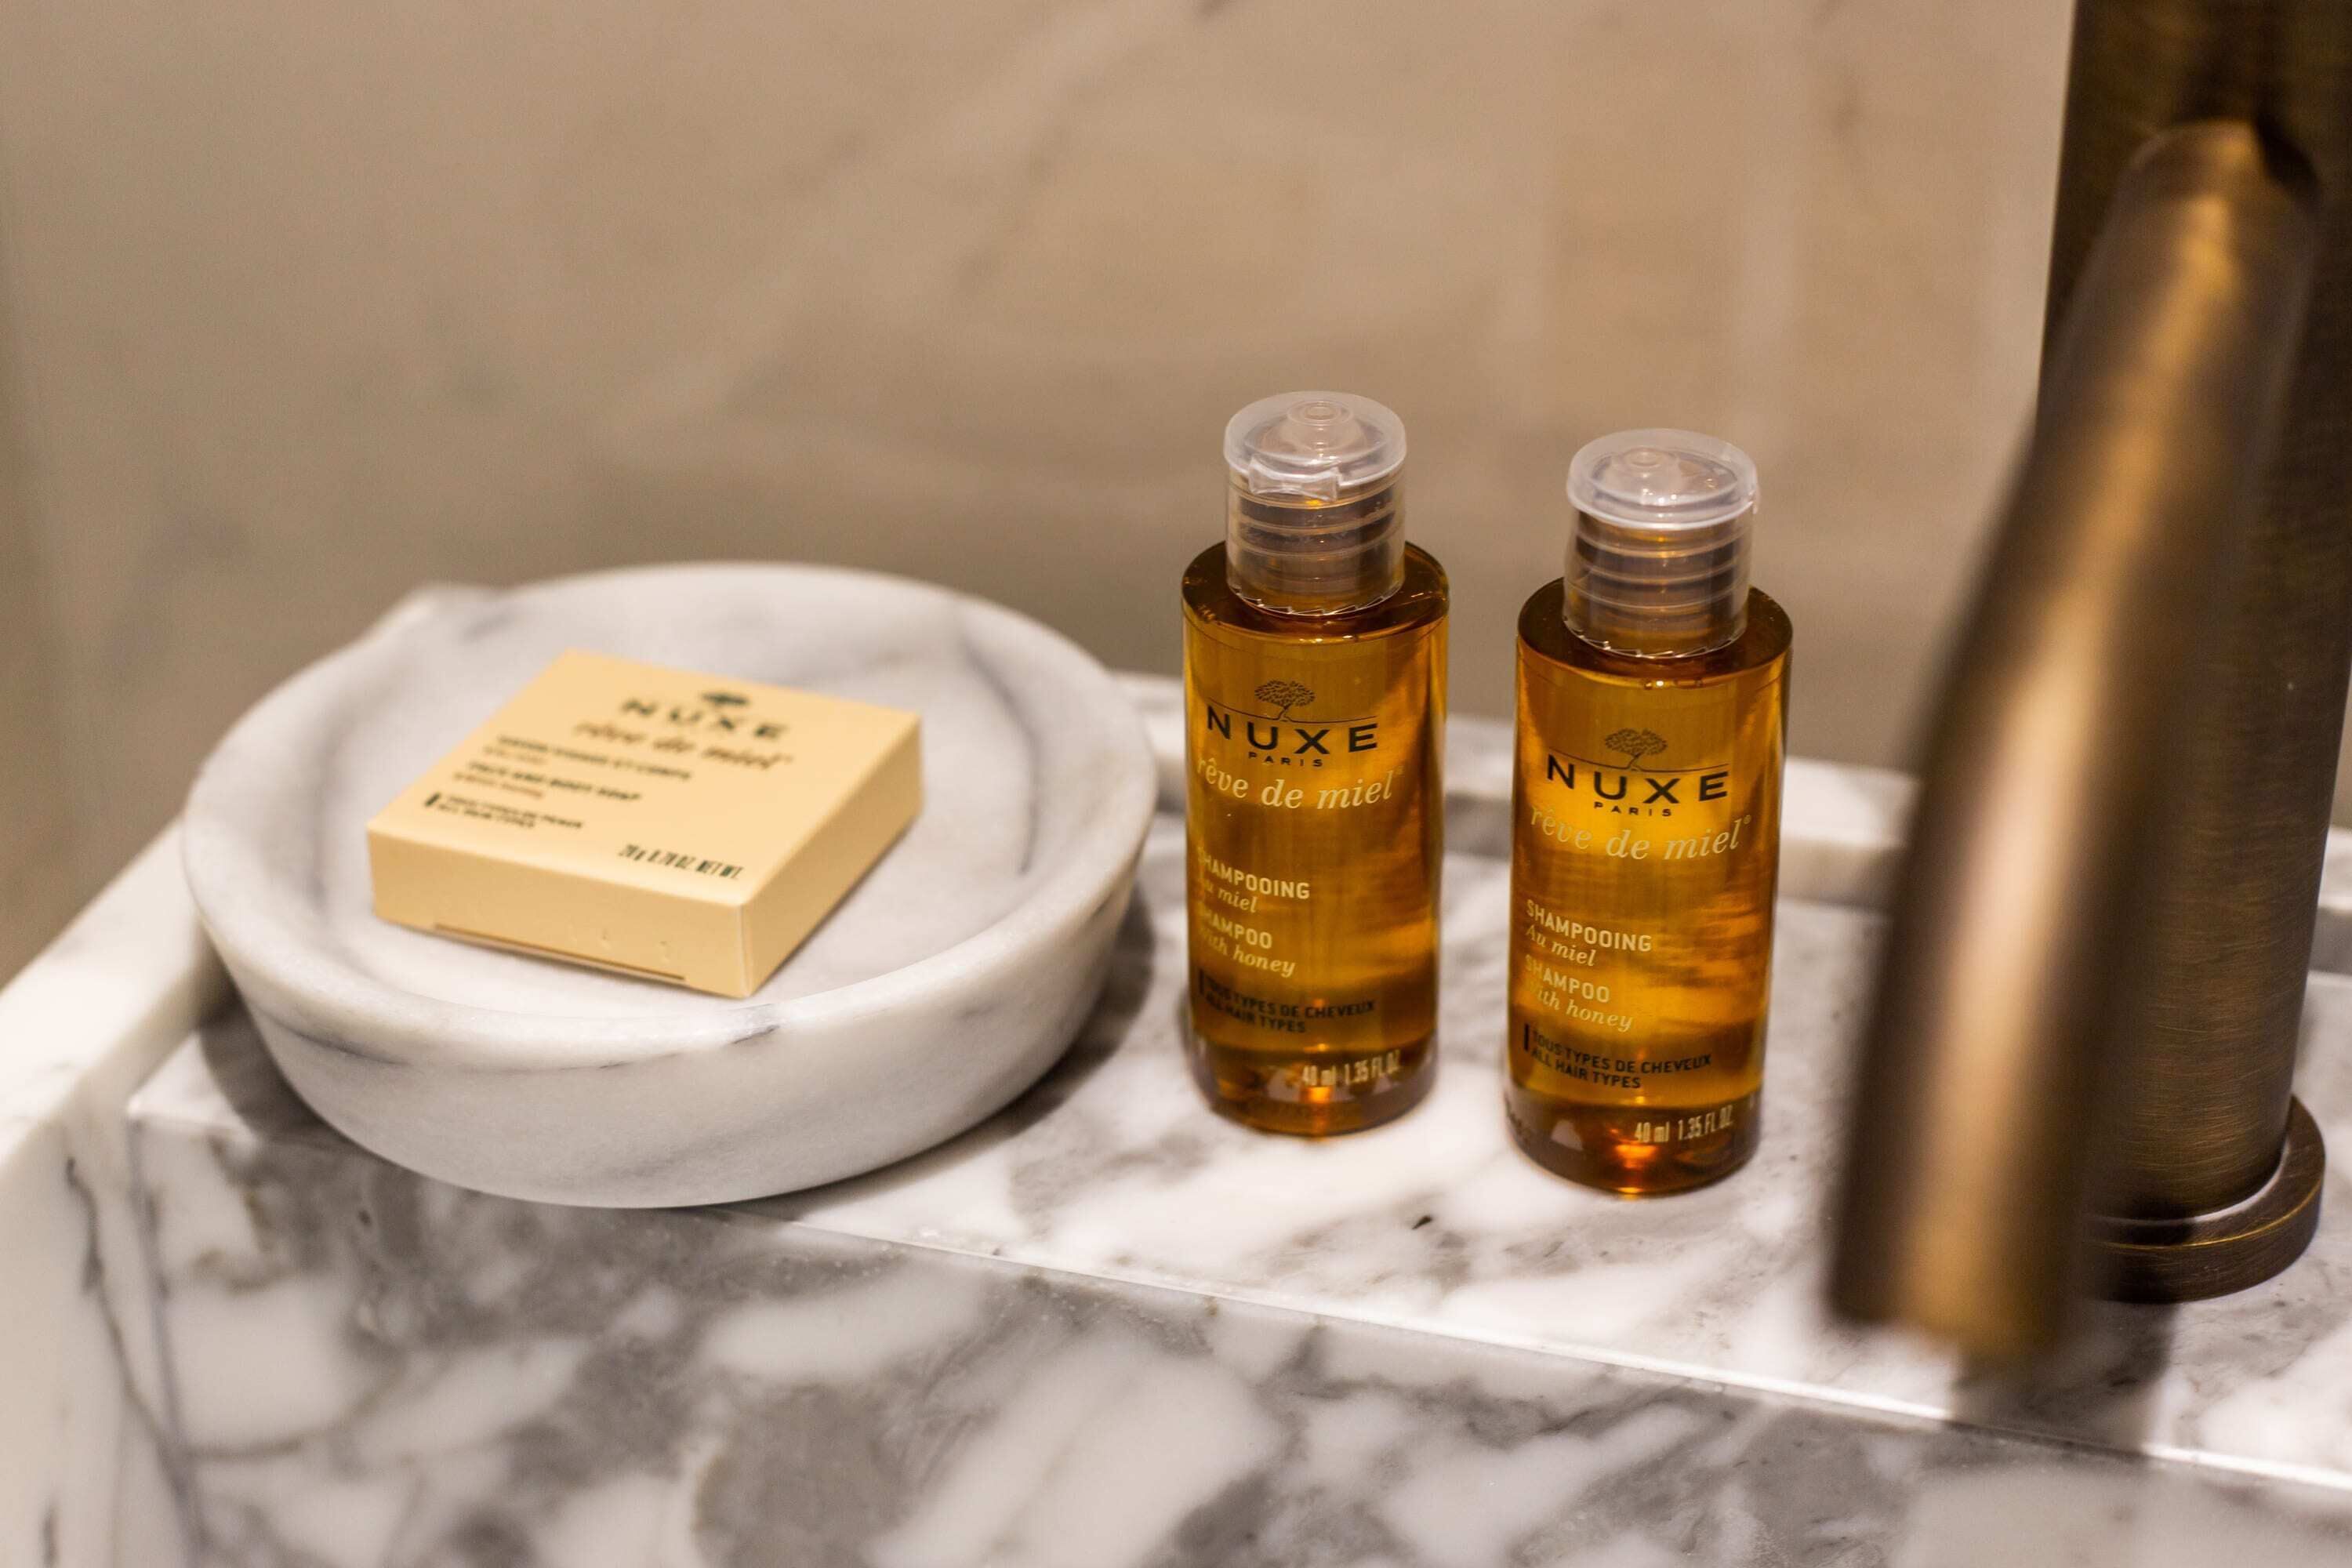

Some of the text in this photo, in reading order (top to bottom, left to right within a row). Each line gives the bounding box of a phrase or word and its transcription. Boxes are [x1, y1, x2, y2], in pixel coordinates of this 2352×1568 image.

[622, 697, 786, 739] NUXE
[1207, 705, 1377, 754] NUXE
[1249, 752, 1323, 767] PARIS
[1547, 753, 1730, 804] NUXE
[1197, 757, 1248, 798] rêve
[1261, 779, 1303, 808] de
[1594, 801, 1671, 817] PARIS
[1530, 804, 1592, 850] rêve
[1606, 829, 1650, 860] de
[1218, 887, 1258, 913] miel
[1198, 901, 1273, 949] HAMPOO
[1526, 898, 1652, 952] SHAMPOOING
[1526, 924, 1596, 967] Au miel
[1233, 945, 1296, 978] honey
[1525, 954, 1610, 1003] SHAMPOO
[1234, 993, 1276, 1014] TYPES
[1280, 1004, 1298, 1018] DE
[1305, 1000, 1375, 1019] CHEVEUX
[1261, 1015, 1305, 1033] TYPES
[1566, 999, 1633, 1033] honey
[1531, 1048, 1642, 1089] ALL HAIR TYPES
[1532, 1029, 1712, 1075] TOUS TYPES DE CHEVEUX
[1635, 1122, 1650, 1142] 40
[1678, 1115, 1702, 1140] 1.35
